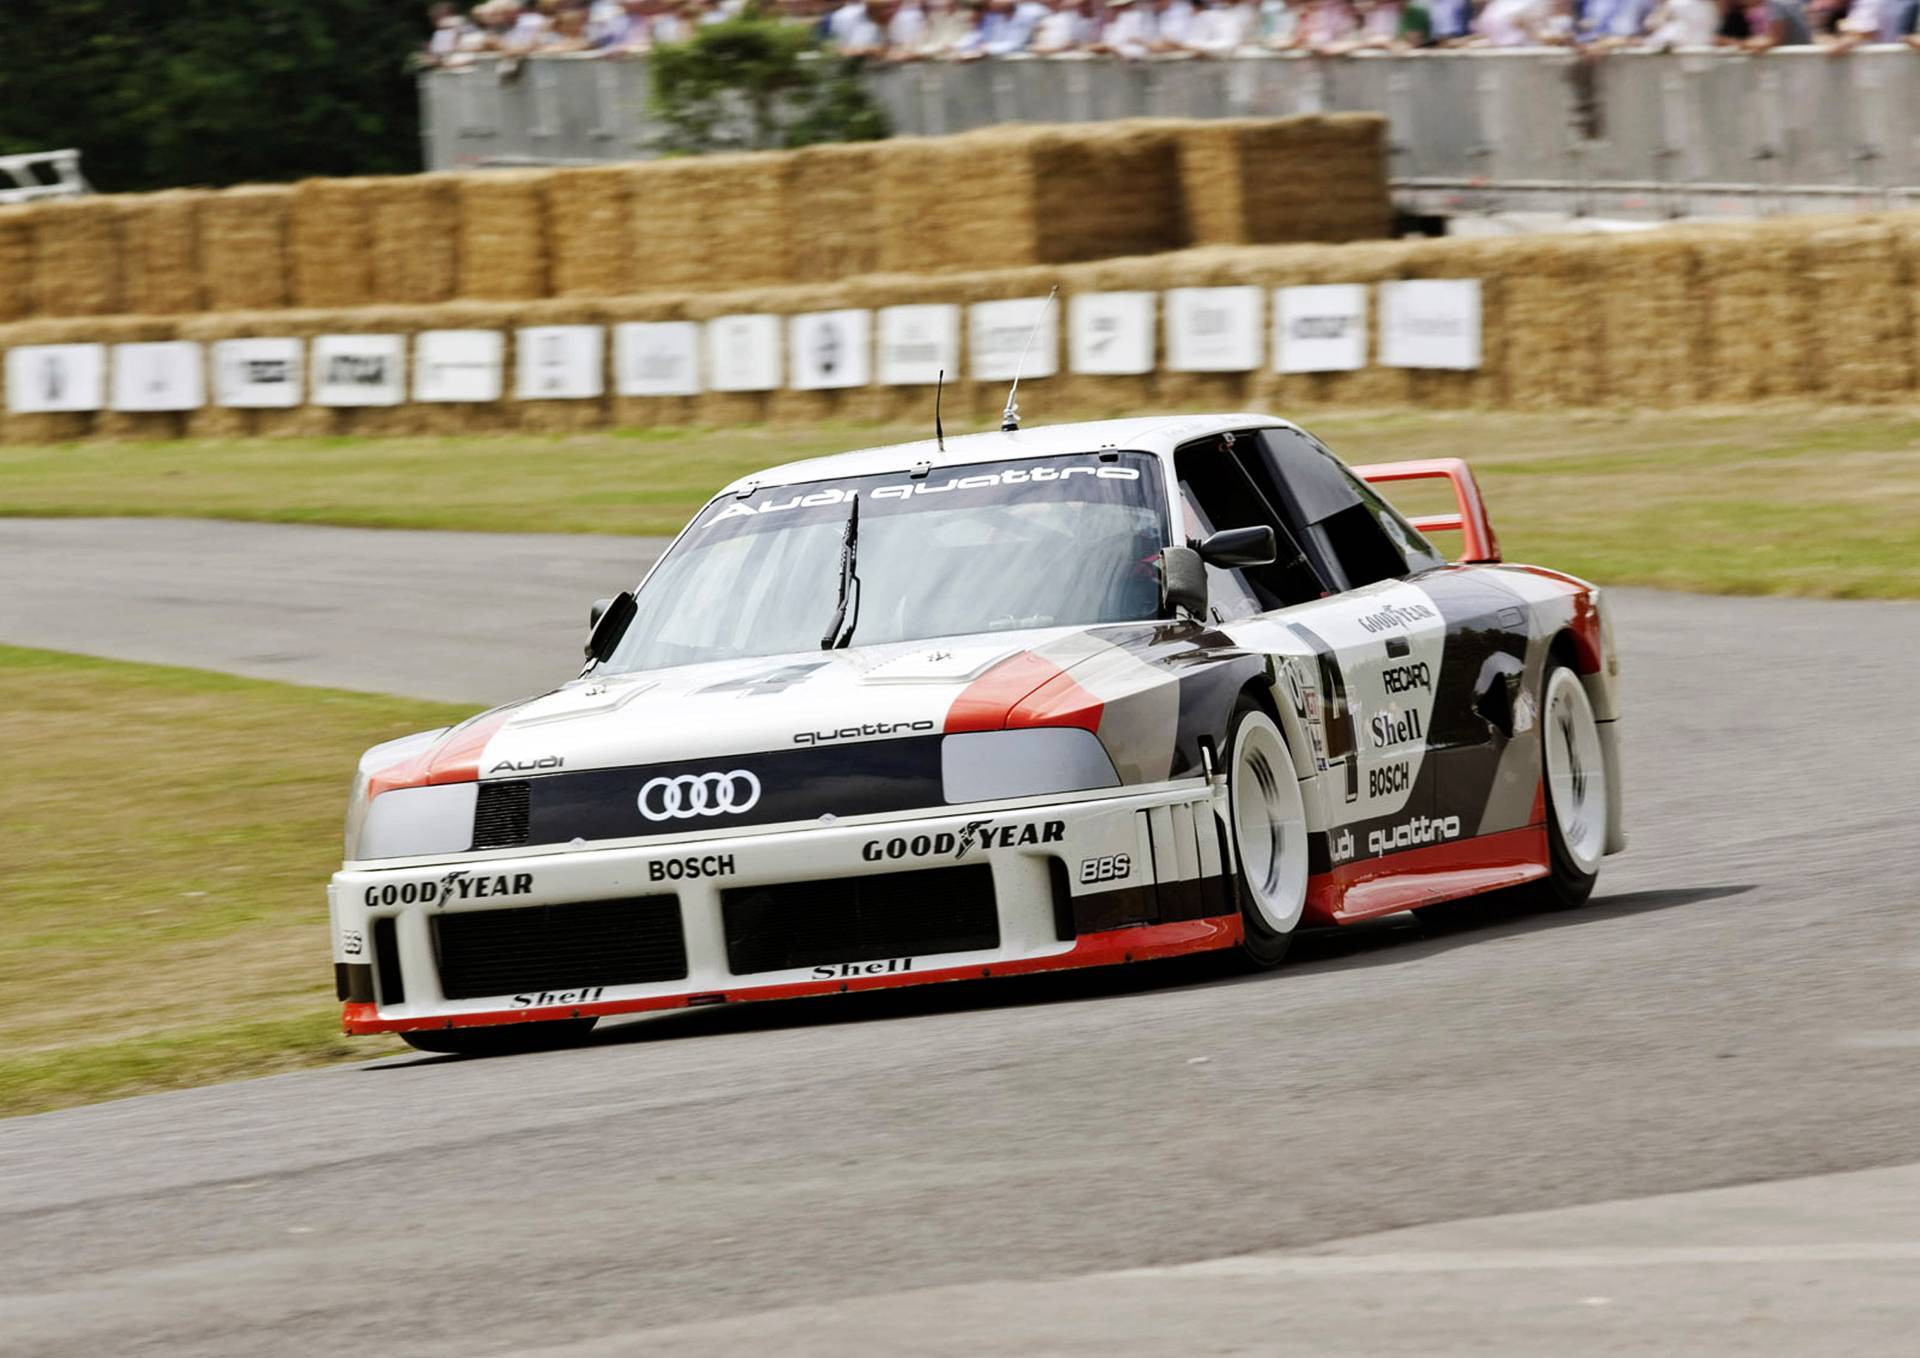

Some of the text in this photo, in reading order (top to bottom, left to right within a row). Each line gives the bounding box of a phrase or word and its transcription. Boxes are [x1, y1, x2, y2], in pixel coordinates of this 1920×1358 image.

[702, 465, 1141, 529] Audi quattro
[793, 719, 934, 746] quattro
[1371, 709, 1423, 749] Shell
[489, 756, 565, 774] Audi
[1369, 761, 1409, 798] BOSCH
[1331, 815, 1460, 861] udi quattro
[648, 854, 735, 881] BOSCH
[1079, 853, 1131, 884] BBS
[811, 957, 915, 981] Shell
[510, 986, 605, 1009] Shell
